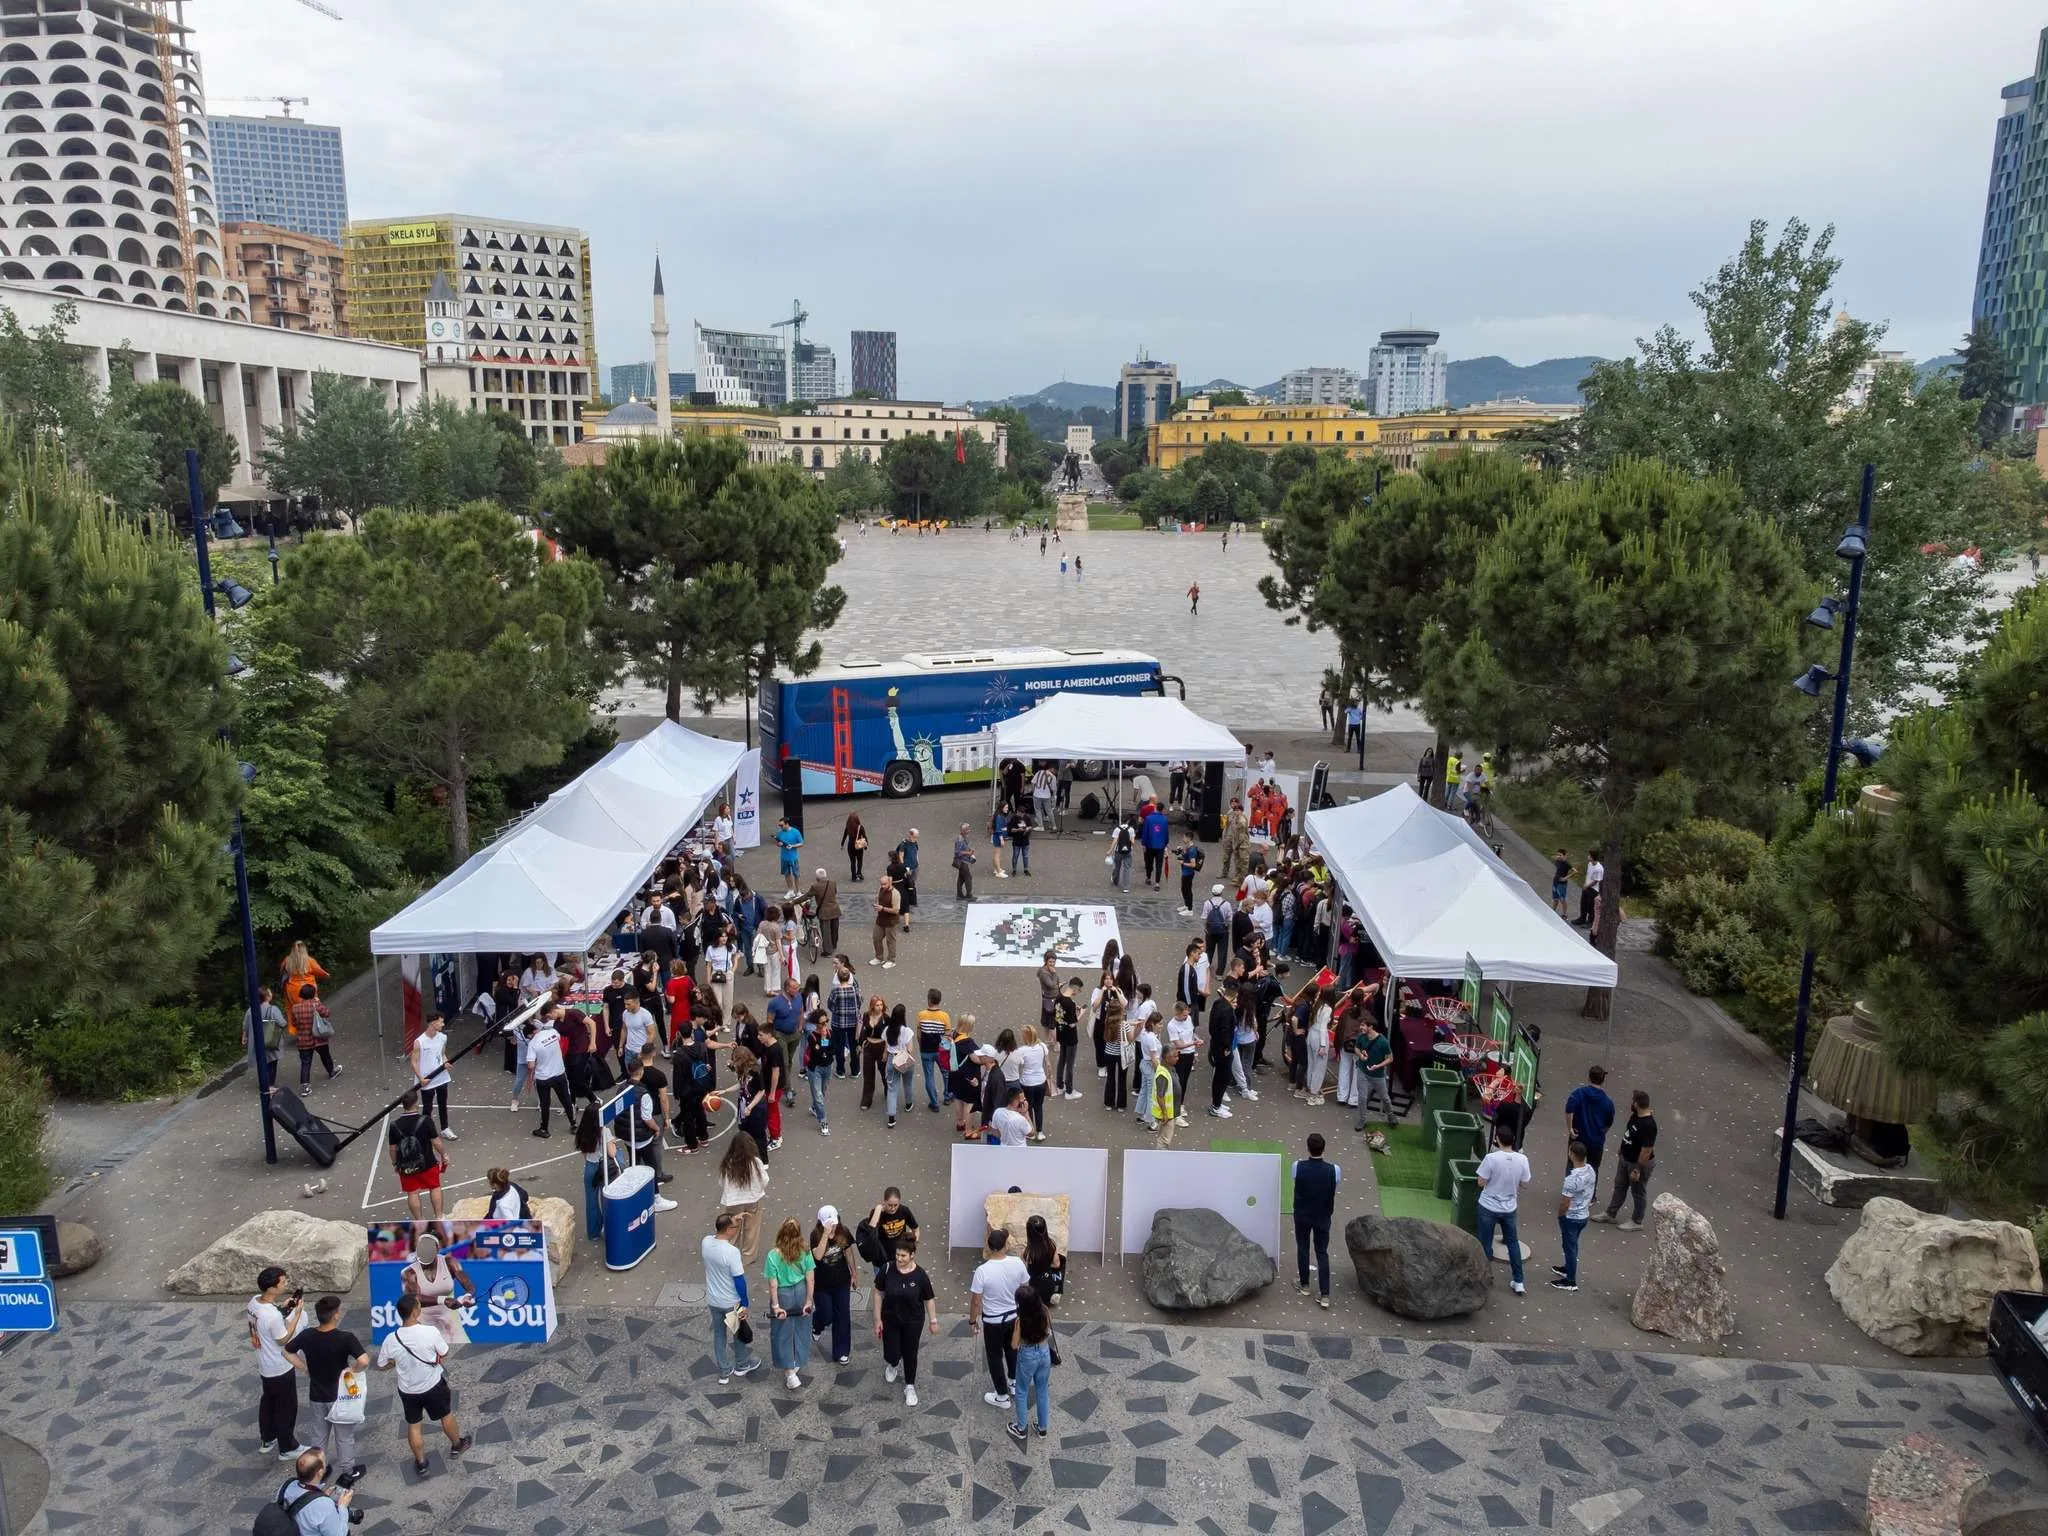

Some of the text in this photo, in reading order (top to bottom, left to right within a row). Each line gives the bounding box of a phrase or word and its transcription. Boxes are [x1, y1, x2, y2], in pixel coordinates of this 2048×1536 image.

[390, 228, 435, 240] SKELA SYLA
[1025, 680, 1061, 690] MOBILE
[0, 1293, 43, 1305] TIONAL
[488, 1295, 546, 1327] Sou
